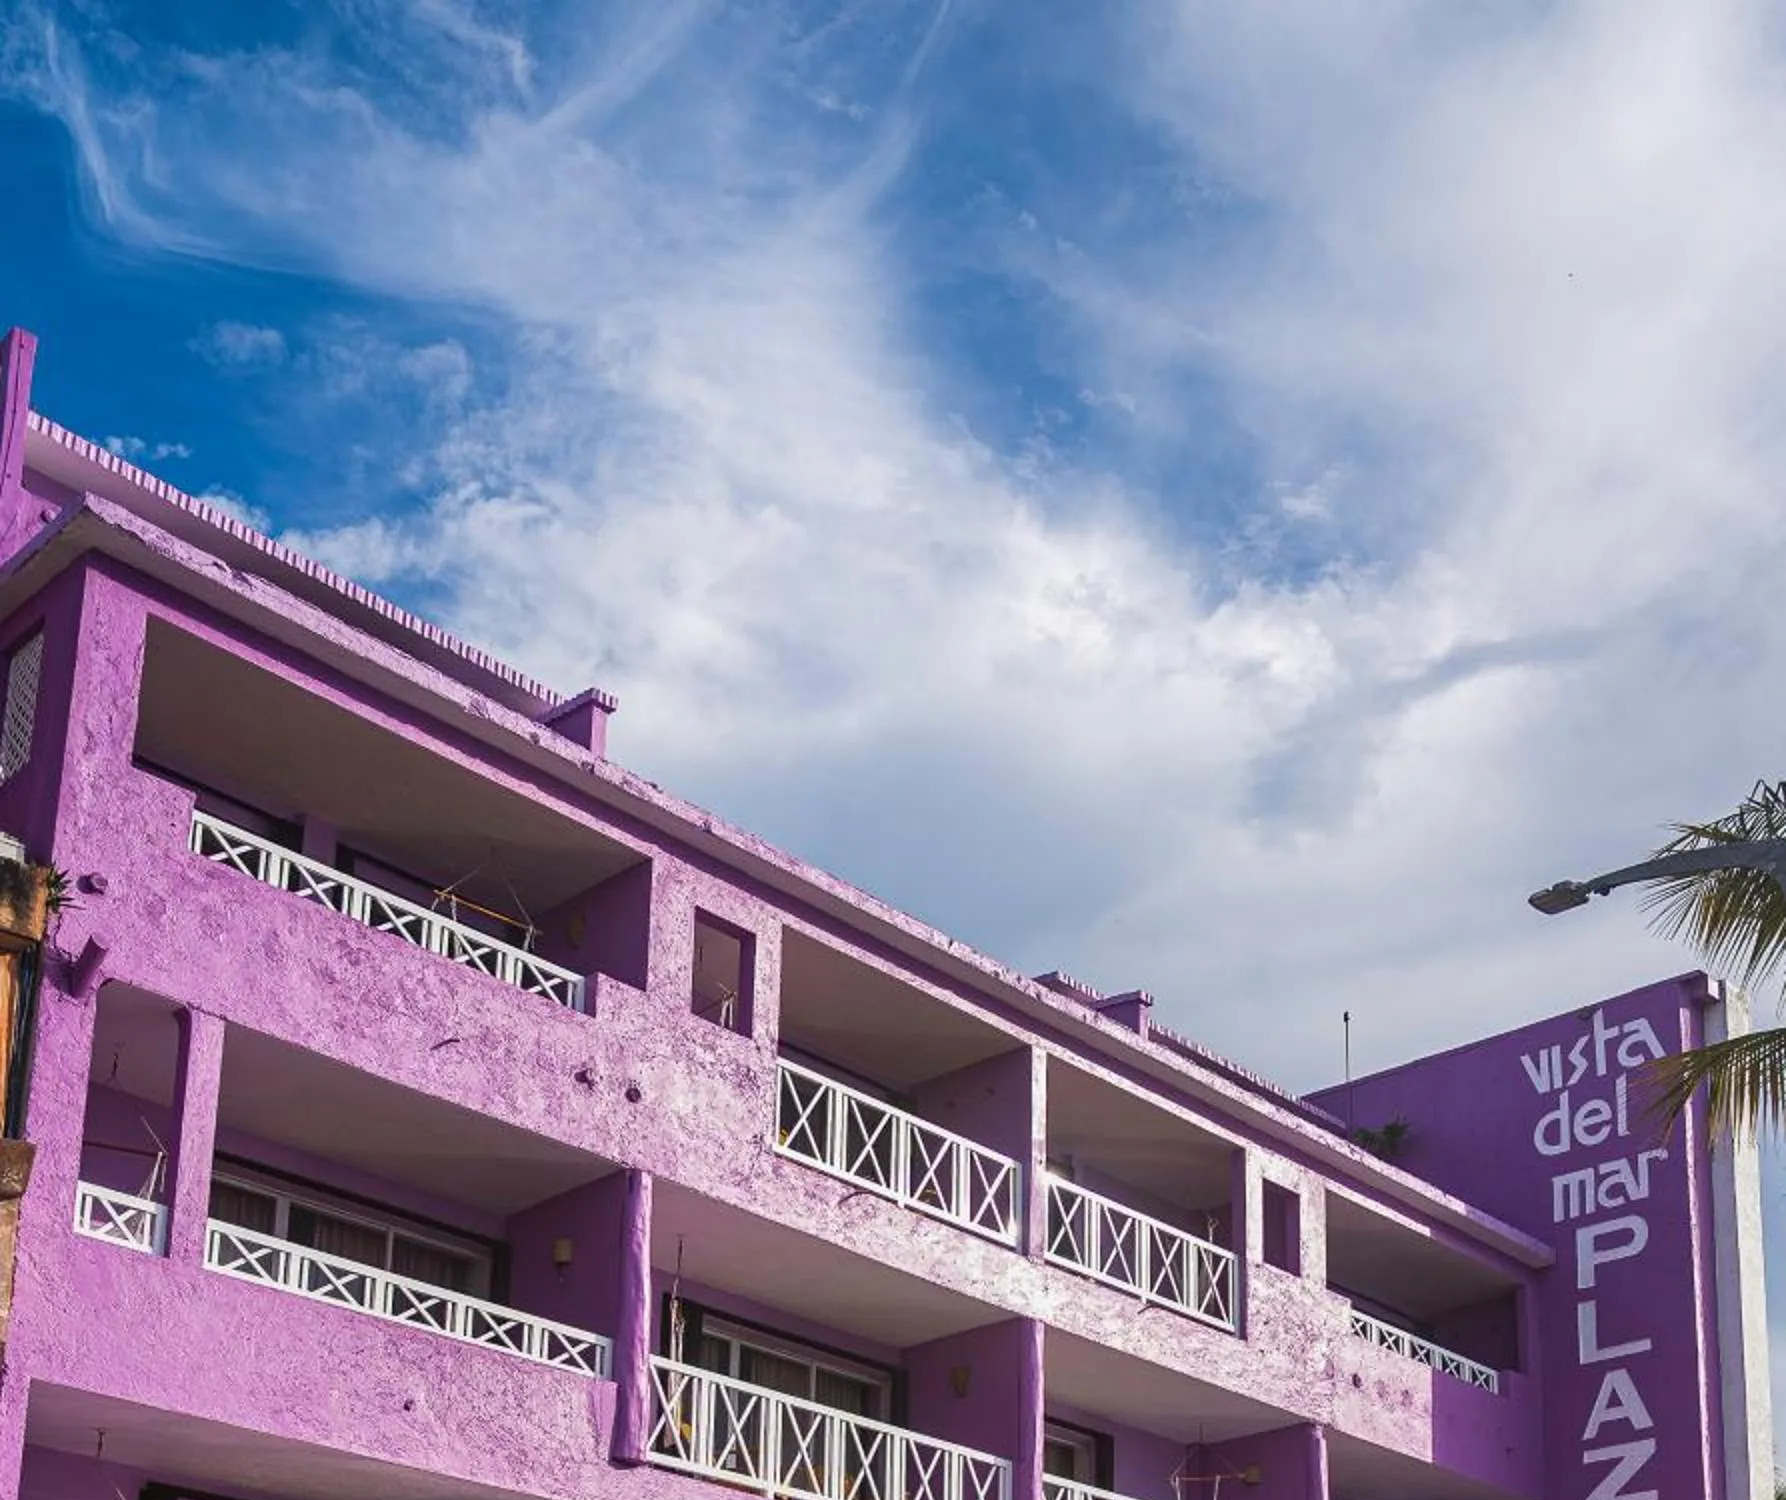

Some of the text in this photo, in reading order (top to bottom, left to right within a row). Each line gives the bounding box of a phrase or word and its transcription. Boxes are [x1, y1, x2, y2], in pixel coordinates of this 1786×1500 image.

[1520, 1008, 1667, 1094] vista
[1533, 1072, 1630, 1156] del
[1552, 1148, 1669, 1223] mar
